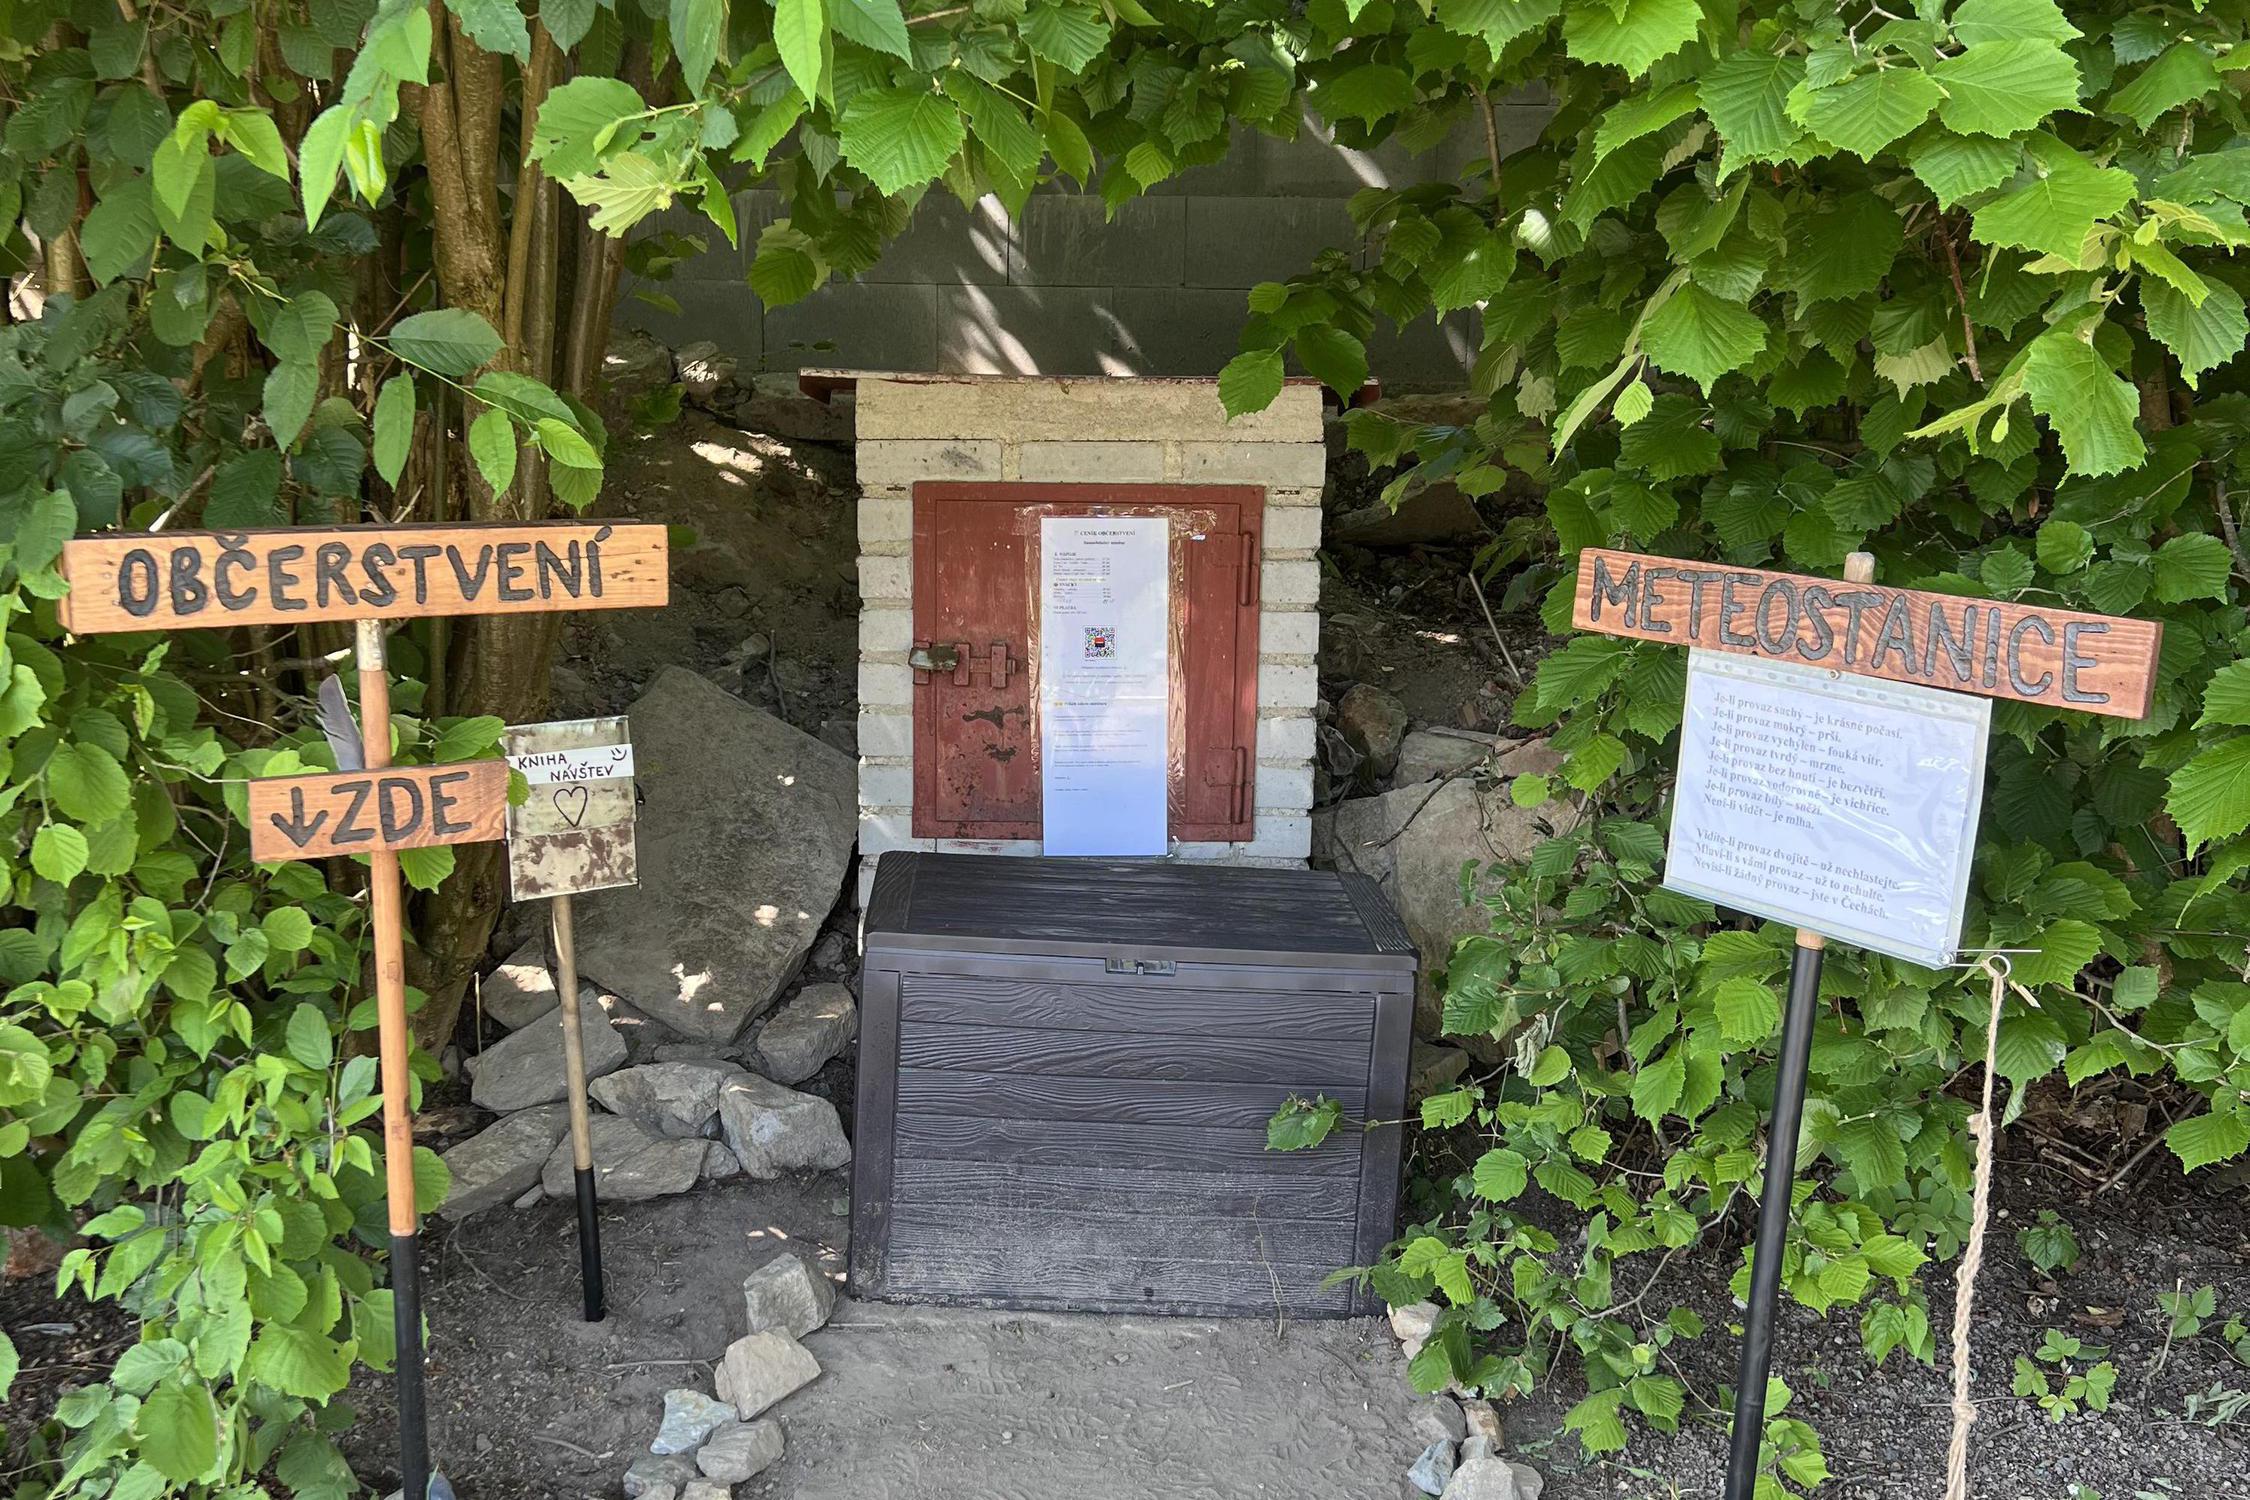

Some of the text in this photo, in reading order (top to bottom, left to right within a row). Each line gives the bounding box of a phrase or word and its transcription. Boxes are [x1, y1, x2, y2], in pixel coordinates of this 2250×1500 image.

[118, 525, 612, 617] OBČERSTVENÍ
[1590, 555, 2110, 704] METEOSTANICE
[1712, 706, 1734, 720] Je-li
[1736, 713, 1771, 728] provaz
[1773, 721, 1805, 737] mokrý
[1817, 730, 1842, 743] prší.
[1713, 692, 1735, 705] Je-li
[1737, 699, 1772, 713] provaz
[1774, 706, 1802, 721] suchý
[1814, 712, 1825, 725] je
[1827, 715, 1863, 732] krásné
[1865, 724, 1903, 740] počasí.
[518, 753, 567, 770] KNIHA
[1709, 736, 1731, 749] Je-li
[1733, 743, 1768, 757] provaz
[1770, 750, 1798, 765] tvrdý
[1809, 759, 1845, 774] mrzne.
[1710, 721, 1733, 735] Je-li
[1734, 728, 1769, 743] provaz
[1828, 746, 1858, 761] fouká
[1861, 753, 1884, 767] vítr.
[550, 761, 614, 782] NÁVŠTEV
[1706, 765, 1728, 778] Je-li
[1830, 793, 1842, 806] je
[1844, 797, 1889, 816] vichřice.
[1731, 757, 1766, 772] provaz
[1768, 763, 1786, 776] bez
[1789, 767, 1817, 783] hnutí
[1826, 776, 1838, 788] je
[1840, 779, 1886, 799] bezvětří.
[330, 770, 472, 845] ZDE
[1704, 780, 1726, 793] Je-li
[1728, 787, 1762, 801] provaz
[1765, 793, 1784, 808] bílý
[1795, 802, 1823, 816] sněží.
[1704, 793, 1736, 810] Není-li
[1739, 803, 1763, 816] vidět
[1772, 810, 1784, 822] je
[1785, 815, 1815, 829] mlha.
[1737, 841, 1771, 856] provaz
[1820, 861, 1833, 872] už
[1835, 866, 1900, 890] nechlastejte.
[1742, 856, 1767, 870] vámi
[1769, 863, 1804, 880] provaz
[1815, 876, 1827, 887] už
[1830, 879, 1840, 890] to
[1734, 868, 1763, 886] žádný
[1765, 878, 1800, 895] provaz
[1810, 888, 1830, 902] jste
[1841, 894, 1889, 920] Čechách.
